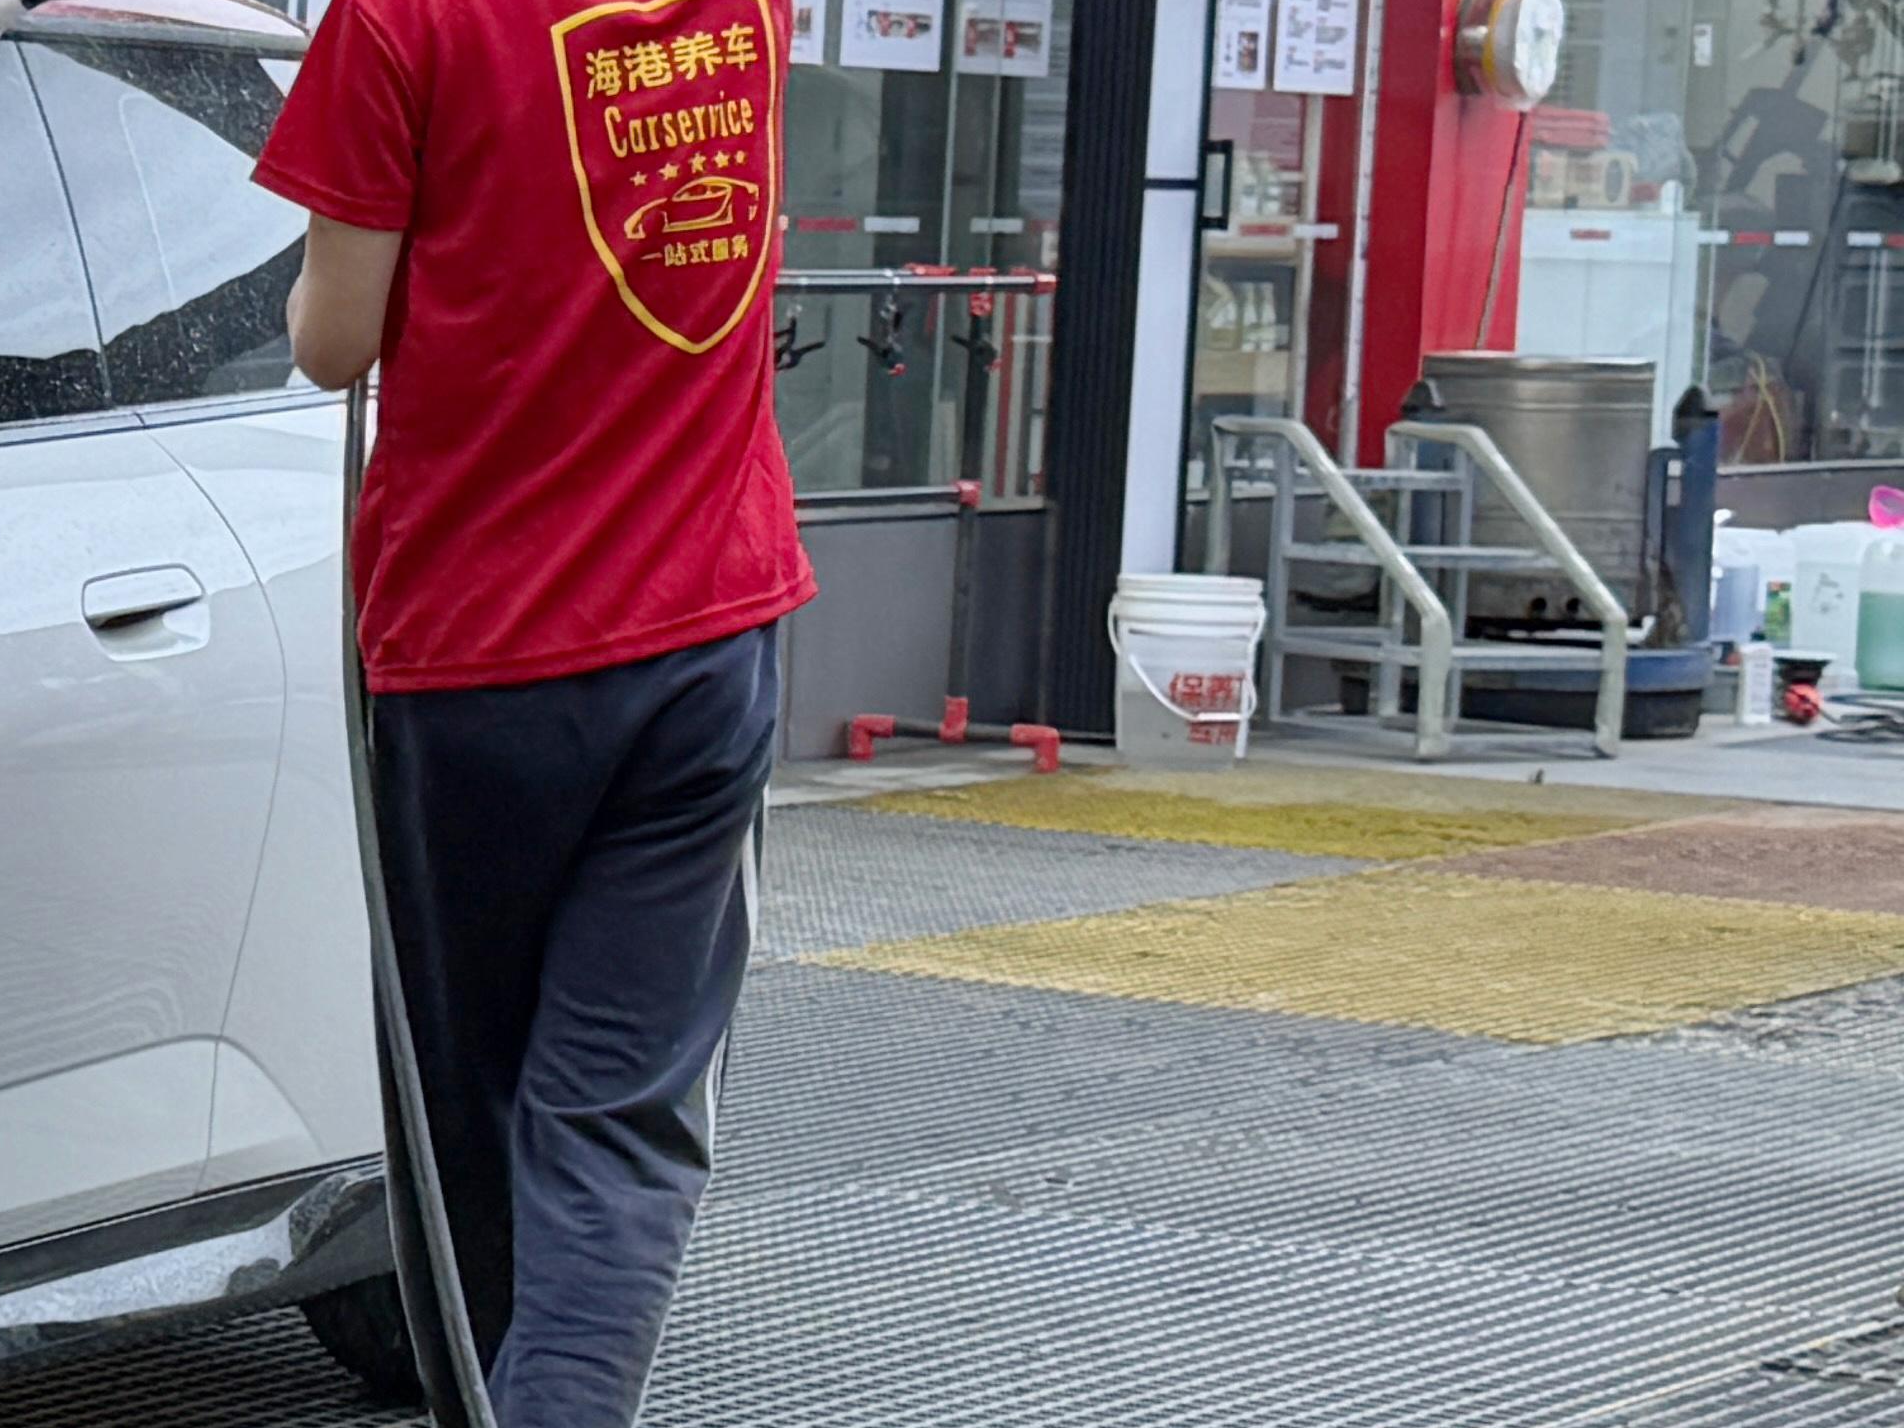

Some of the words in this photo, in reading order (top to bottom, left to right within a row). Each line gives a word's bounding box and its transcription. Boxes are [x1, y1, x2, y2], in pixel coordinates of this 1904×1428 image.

[584, 22, 758, 100] 海港养车
[603, 91, 756, 159] Carservice
[640, 235, 750, 268] 一站式服务
